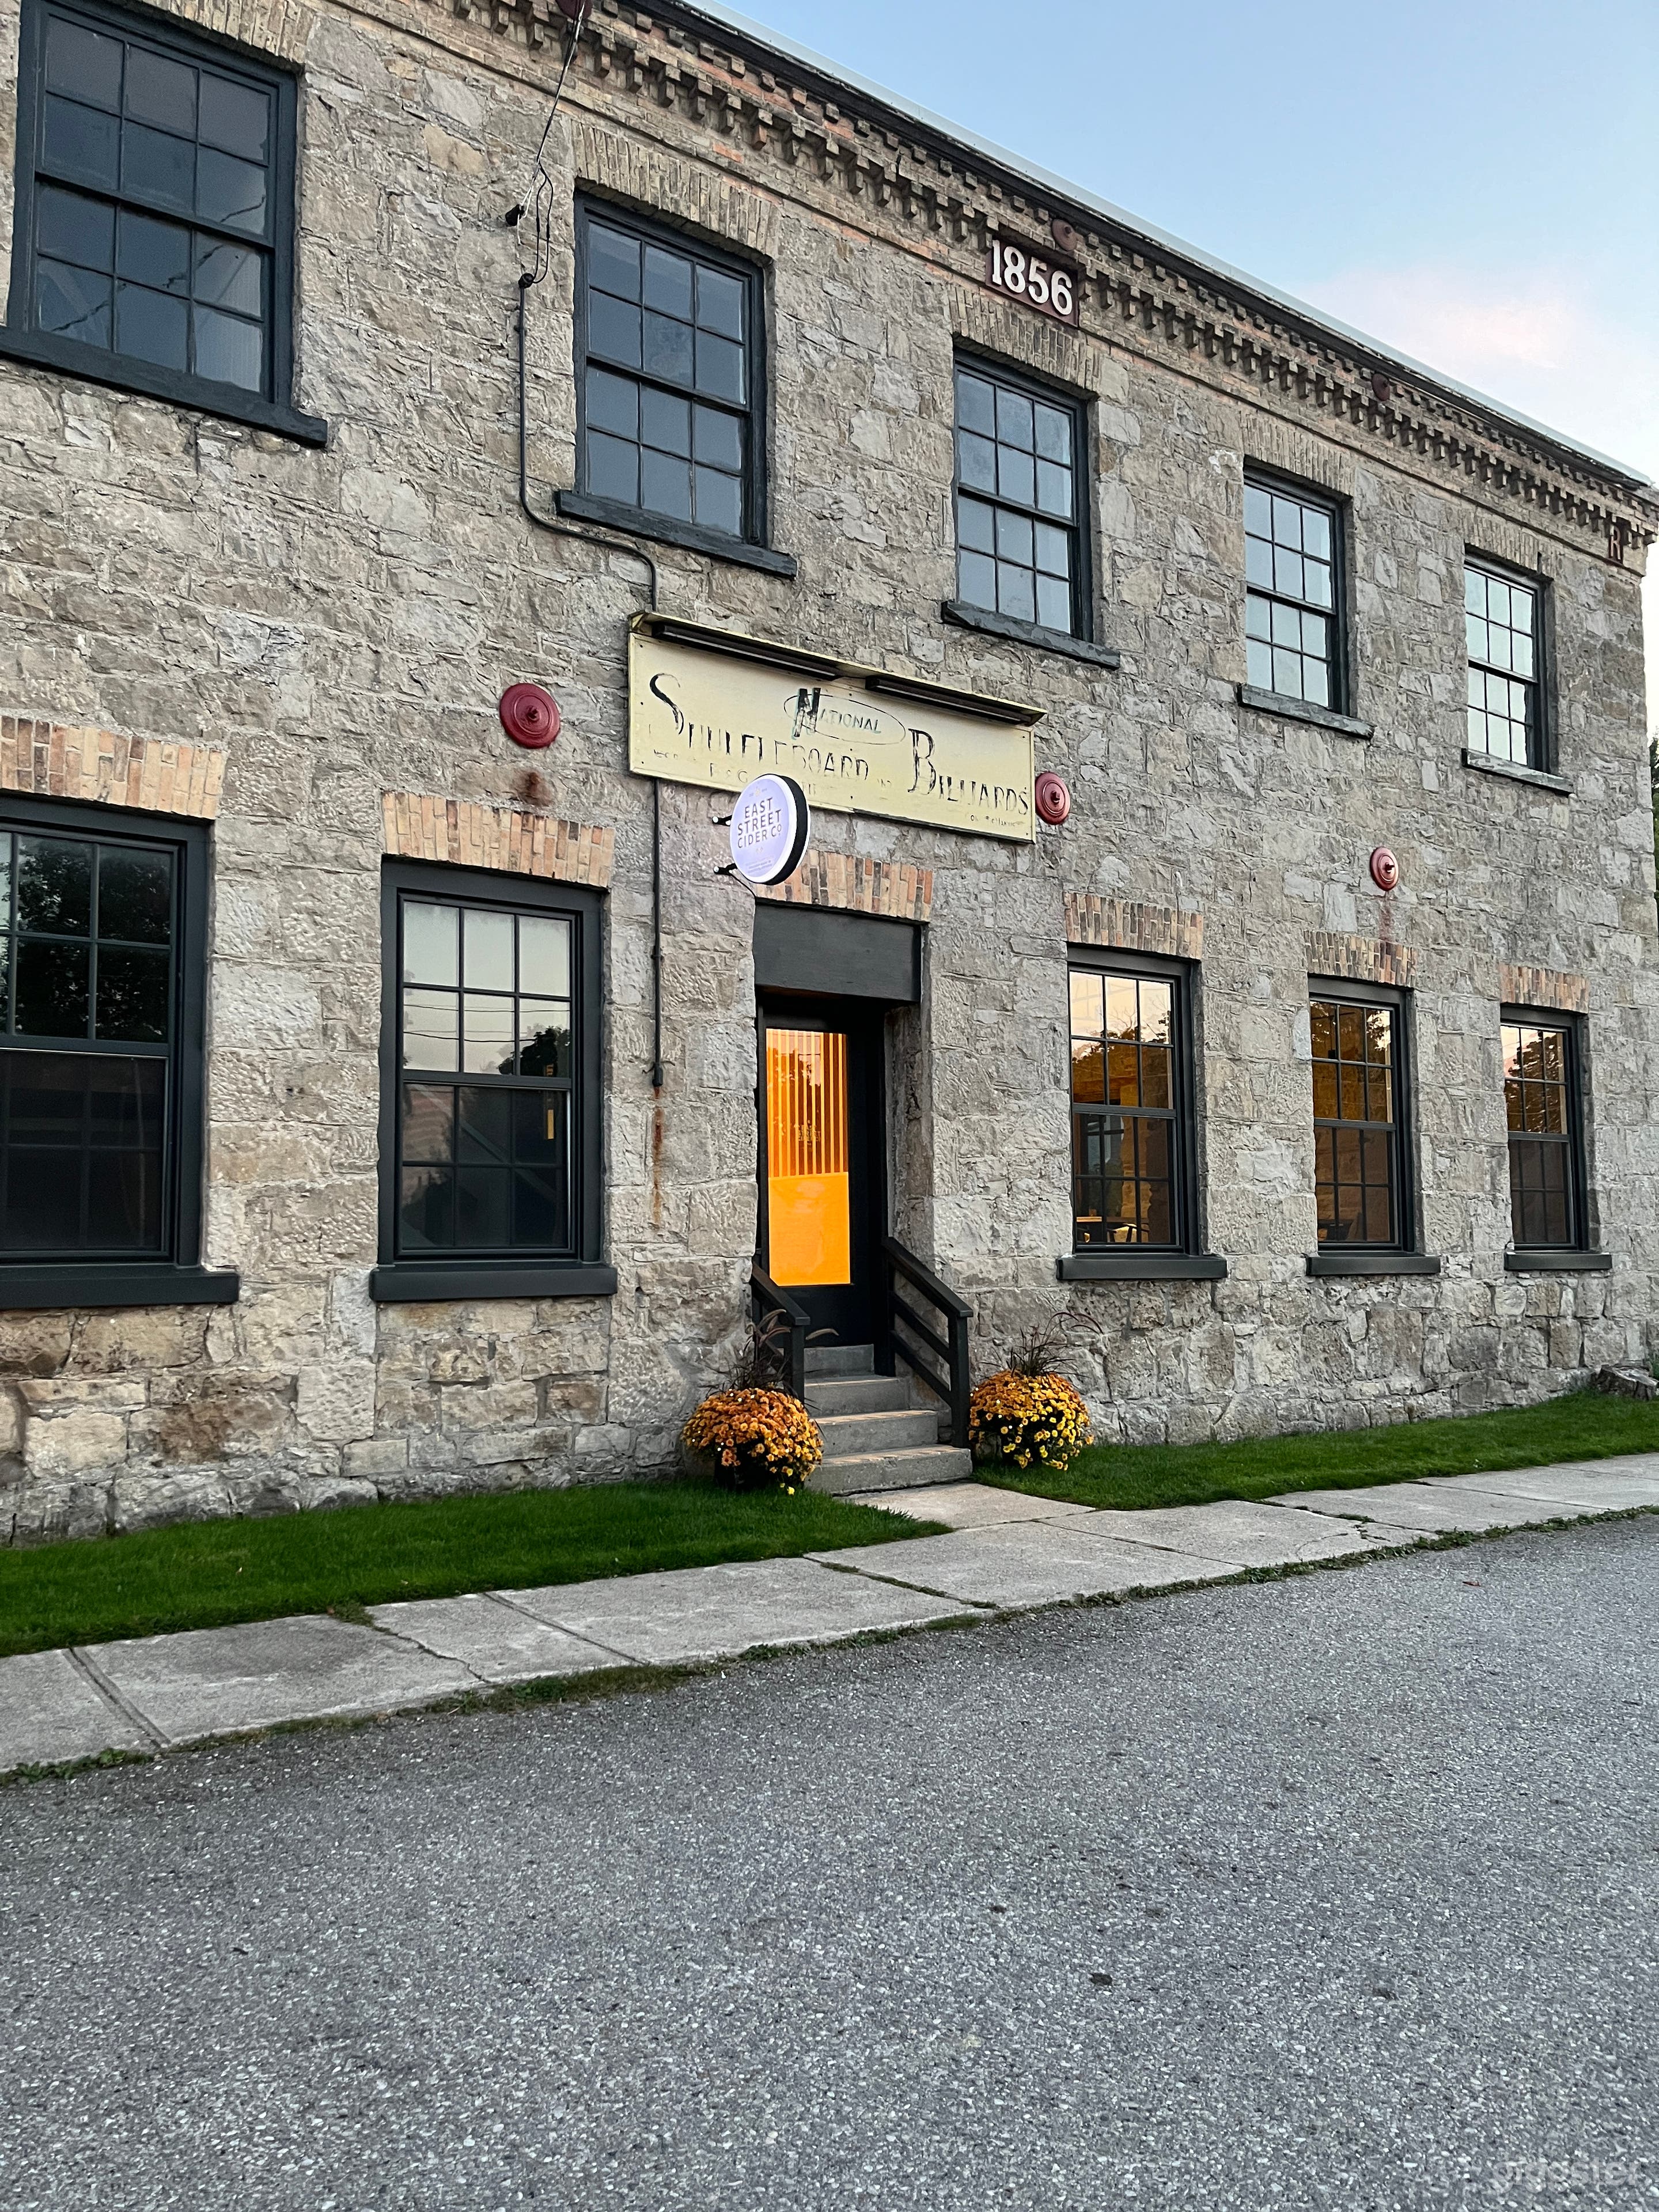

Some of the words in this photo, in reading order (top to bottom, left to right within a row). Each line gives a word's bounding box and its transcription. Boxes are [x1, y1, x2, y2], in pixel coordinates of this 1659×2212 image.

[992, 240, 1072, 315] 1856
[792, 687, 881, 737] NATIONAL
[745, 797, 772, 819] EAST
[738, 809, 782, 836] STREET
[737, 830, 767, 849] CIDER
